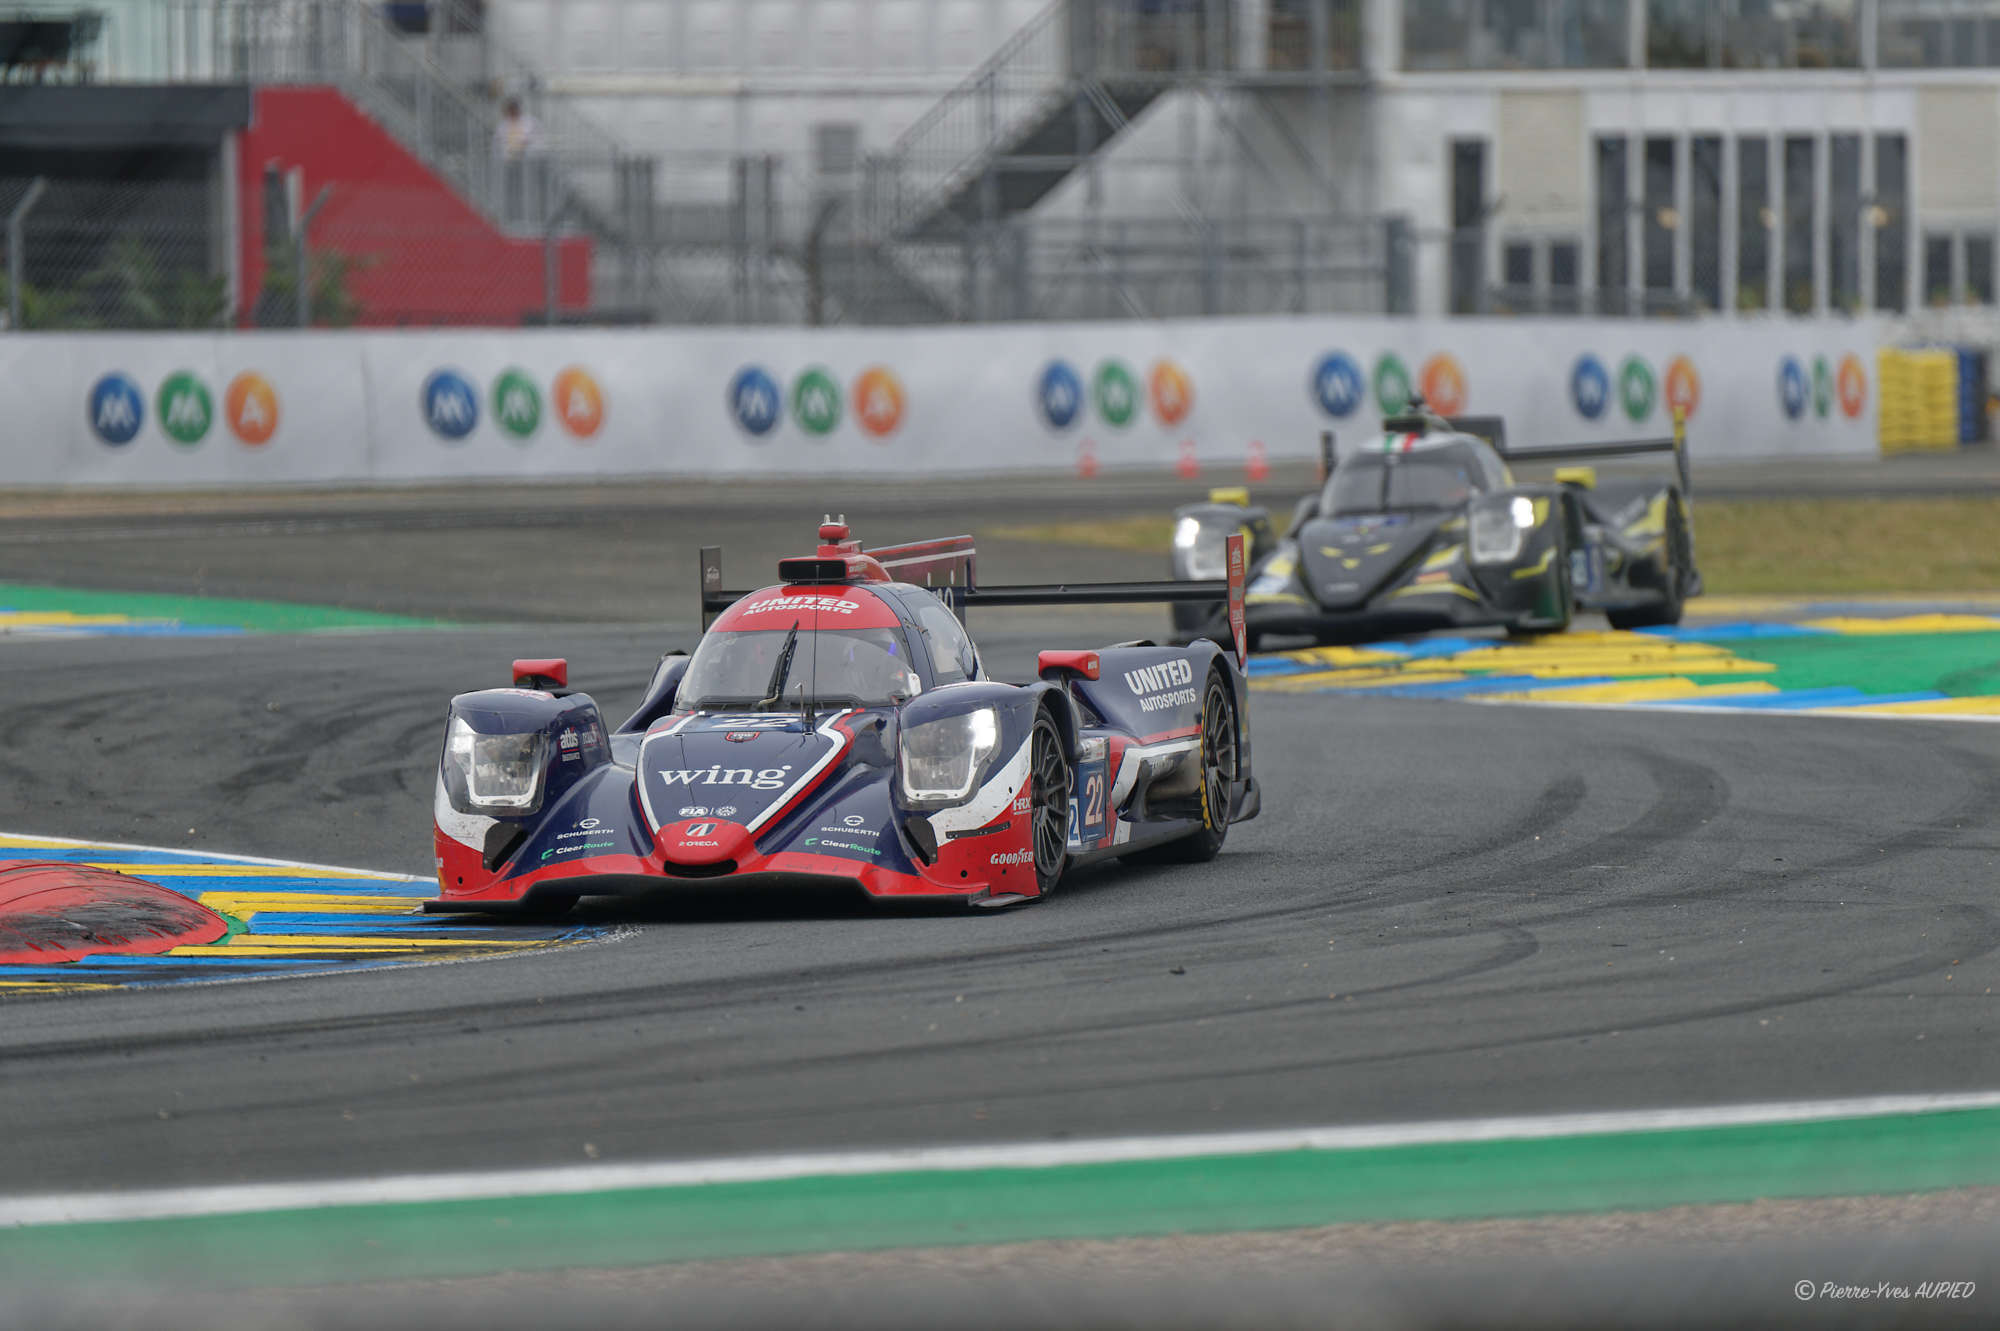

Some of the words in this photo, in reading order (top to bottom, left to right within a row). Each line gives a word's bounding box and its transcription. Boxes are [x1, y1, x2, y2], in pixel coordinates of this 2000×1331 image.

[743, 605, 853, 616] AUTOSPORTS
[749, 597, 860, 610] UNITED
[1124, 659, 1192, 695] UNITED
[1140, 688, 1196, 712] AUTOSPORTS
[658, 765, 792, 790] wing
[1085, 774, 1103, 826] 22
[556, 829, 615, 840] SCHUBERTH
[820, 827, 880, 837] SCHUBERTH
[556, 841, 615, 855] ClearRoute
[820, 840, 881, 855] ClearRoute
